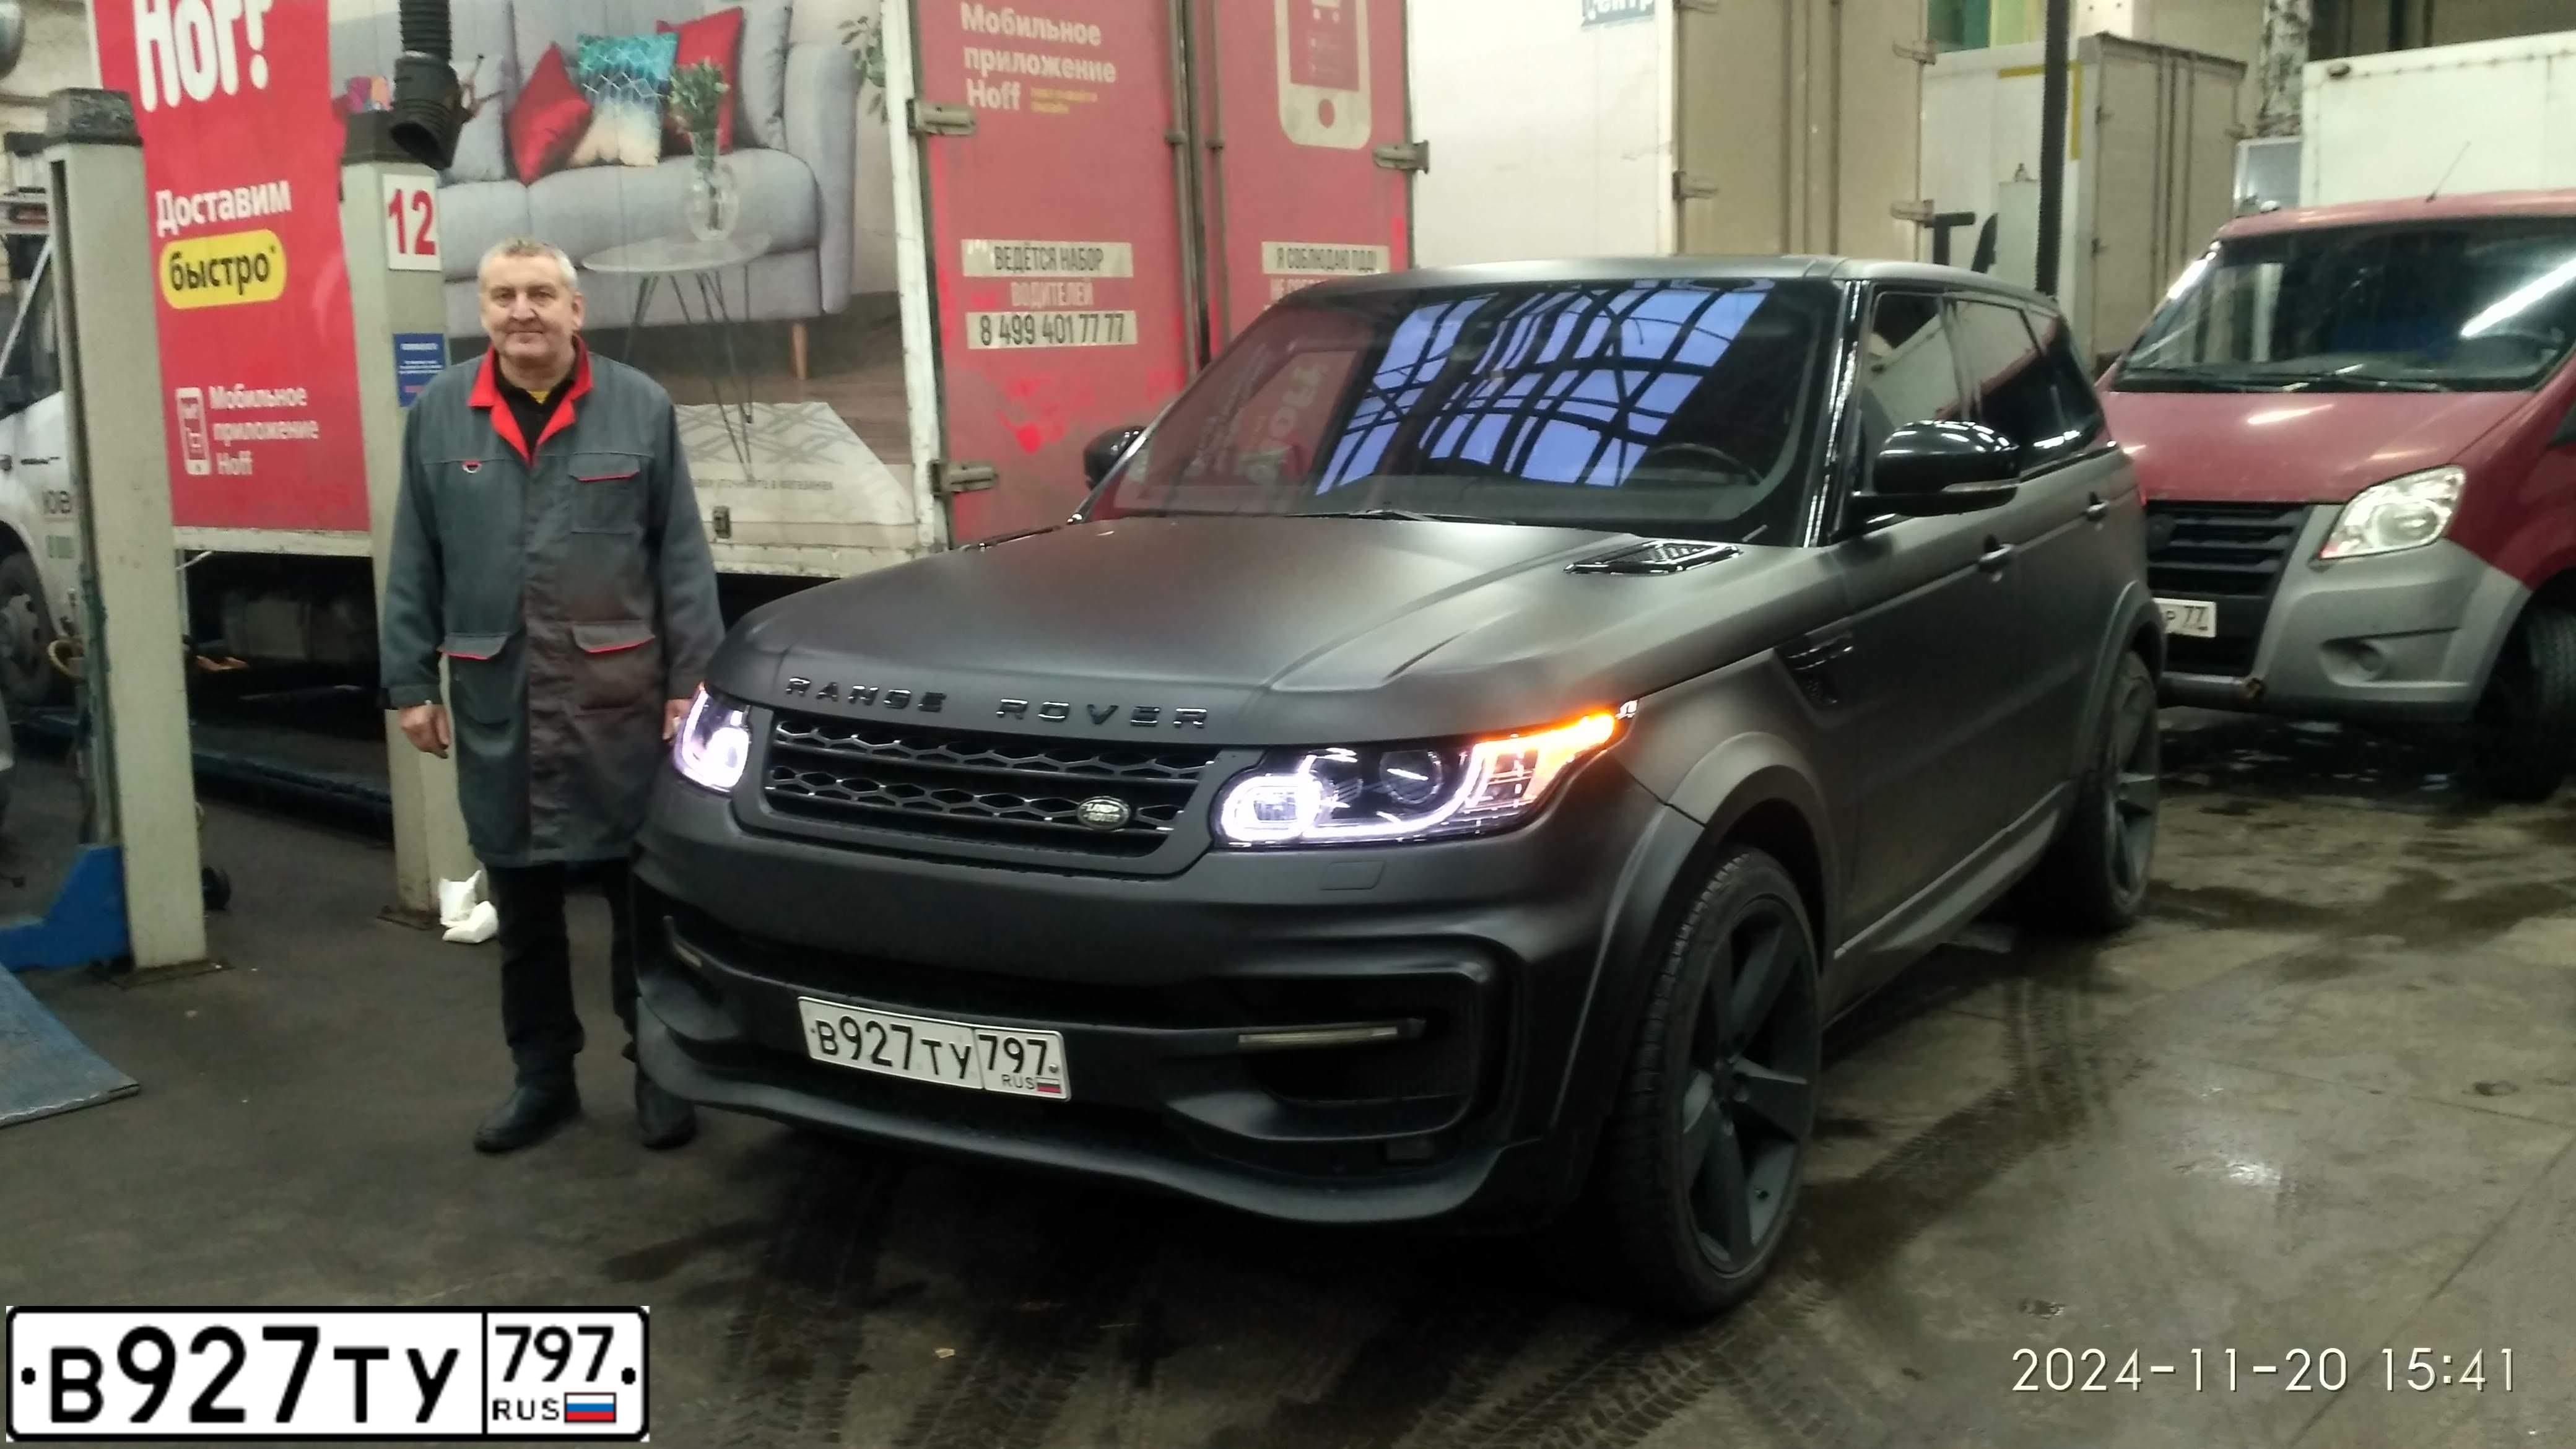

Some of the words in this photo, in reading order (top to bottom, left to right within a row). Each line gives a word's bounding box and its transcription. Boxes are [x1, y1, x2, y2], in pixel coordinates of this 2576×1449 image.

[960, 2, 1102, 46] Мобильное
[964, 46, 1116, 83] приложение
[966, 78, 1020, 111] Hoff
[155, 180, 292, 238] Доставим
[388, 188, 436, 255] 12
[980, 315, 991, 346] 8
[999, 314, 1036, 345] 499
[1042, 313, 1074, 344] 401
[209, 383, 308, 410] Мобильное
[214, 420, 319, 447] приложение
[216, 450, 253, 475] Hoff
[2184, 606, 2208, 628] 77
[786, 677, 947, 713] RANGE
[996, 697, 1208, 728] ROVER
[816, 1016, 972, 1079] В927ТУ
[978, 1033, 1048, 1076] 797
[1001, 1073, 1035, 1090] RUS
